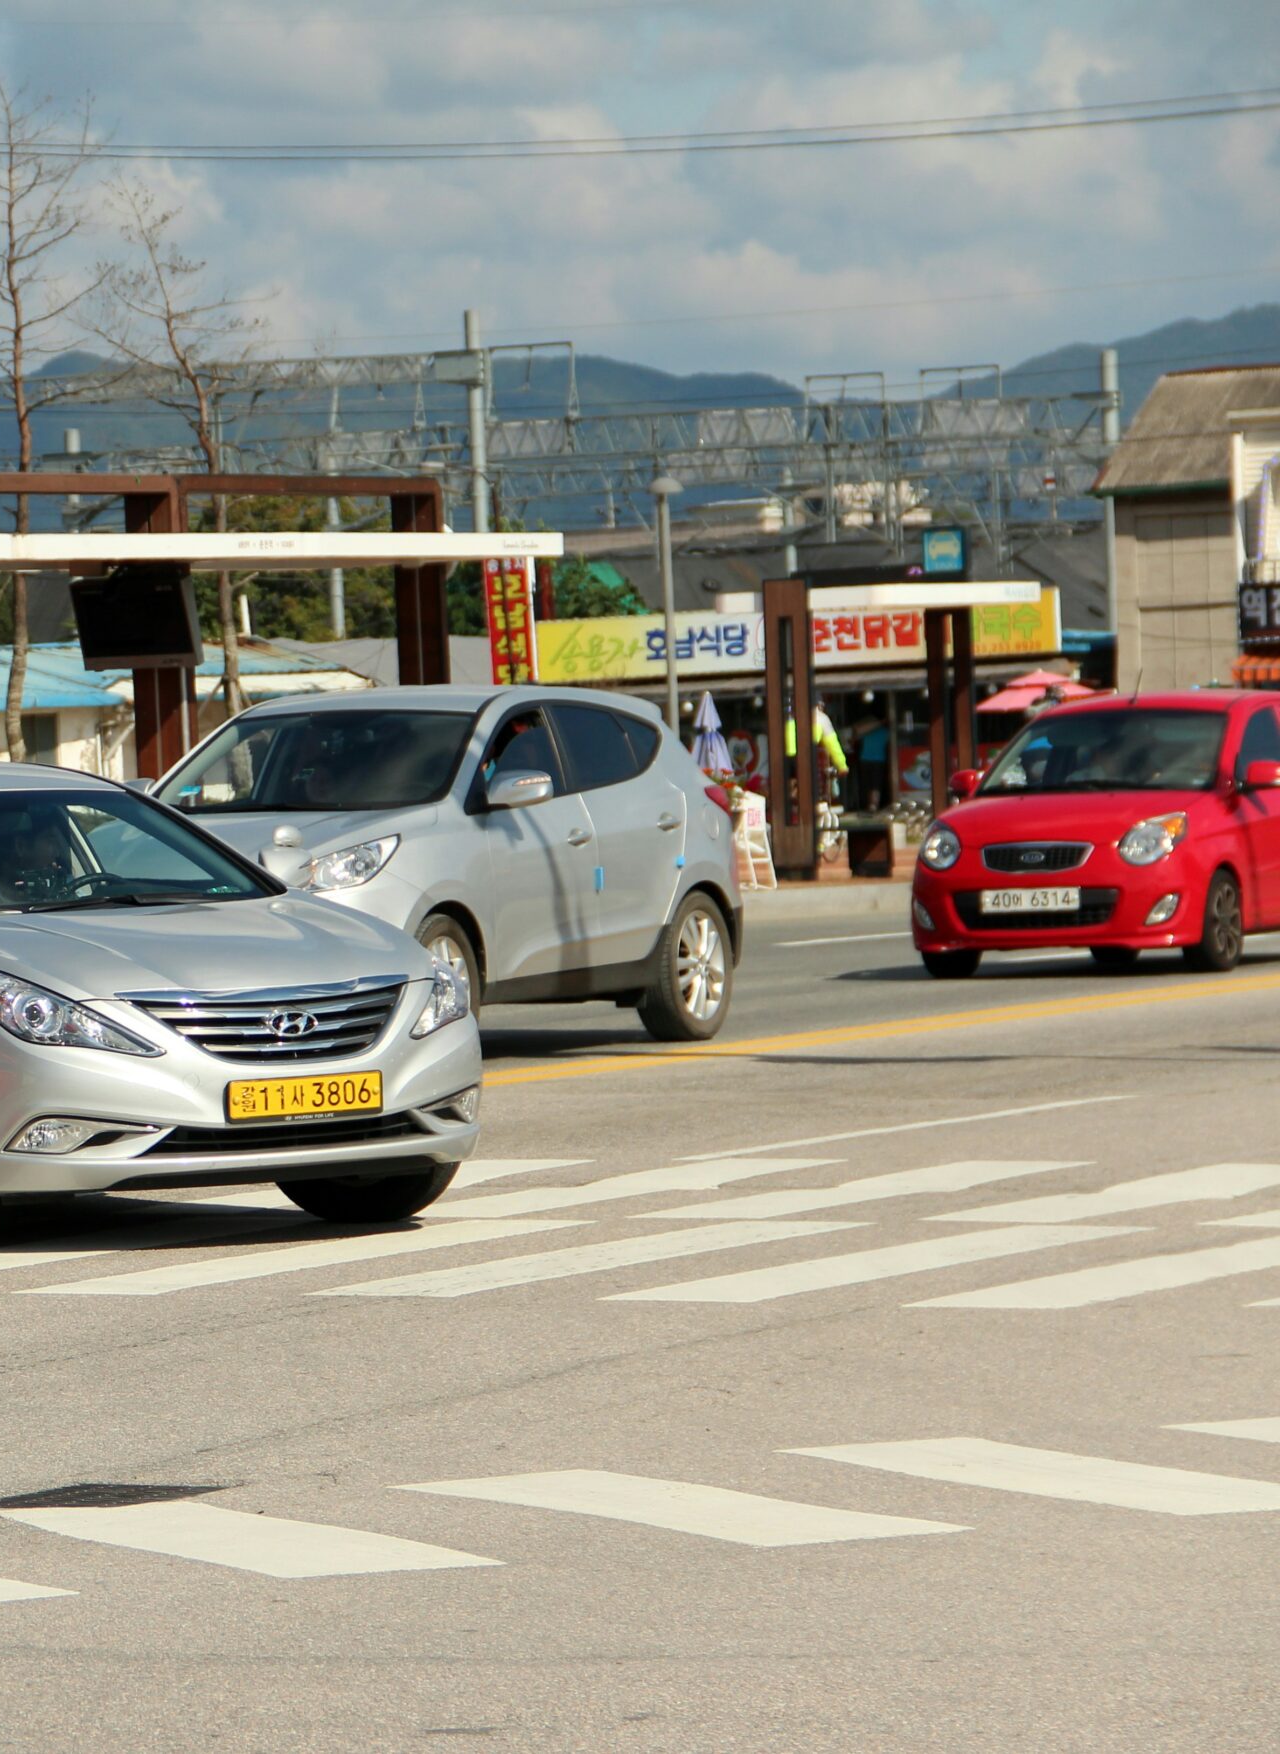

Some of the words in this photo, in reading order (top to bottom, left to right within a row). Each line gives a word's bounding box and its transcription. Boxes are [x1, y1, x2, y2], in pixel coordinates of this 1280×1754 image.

[1241, 588, 1280, 627] 역
[646, 623, 749, 661] 호남식당
[1030, 890, 1071, 907] 6314
[259, 1084, 305, 1111] 11사
[311, 1078, 372, 1107] 3806
